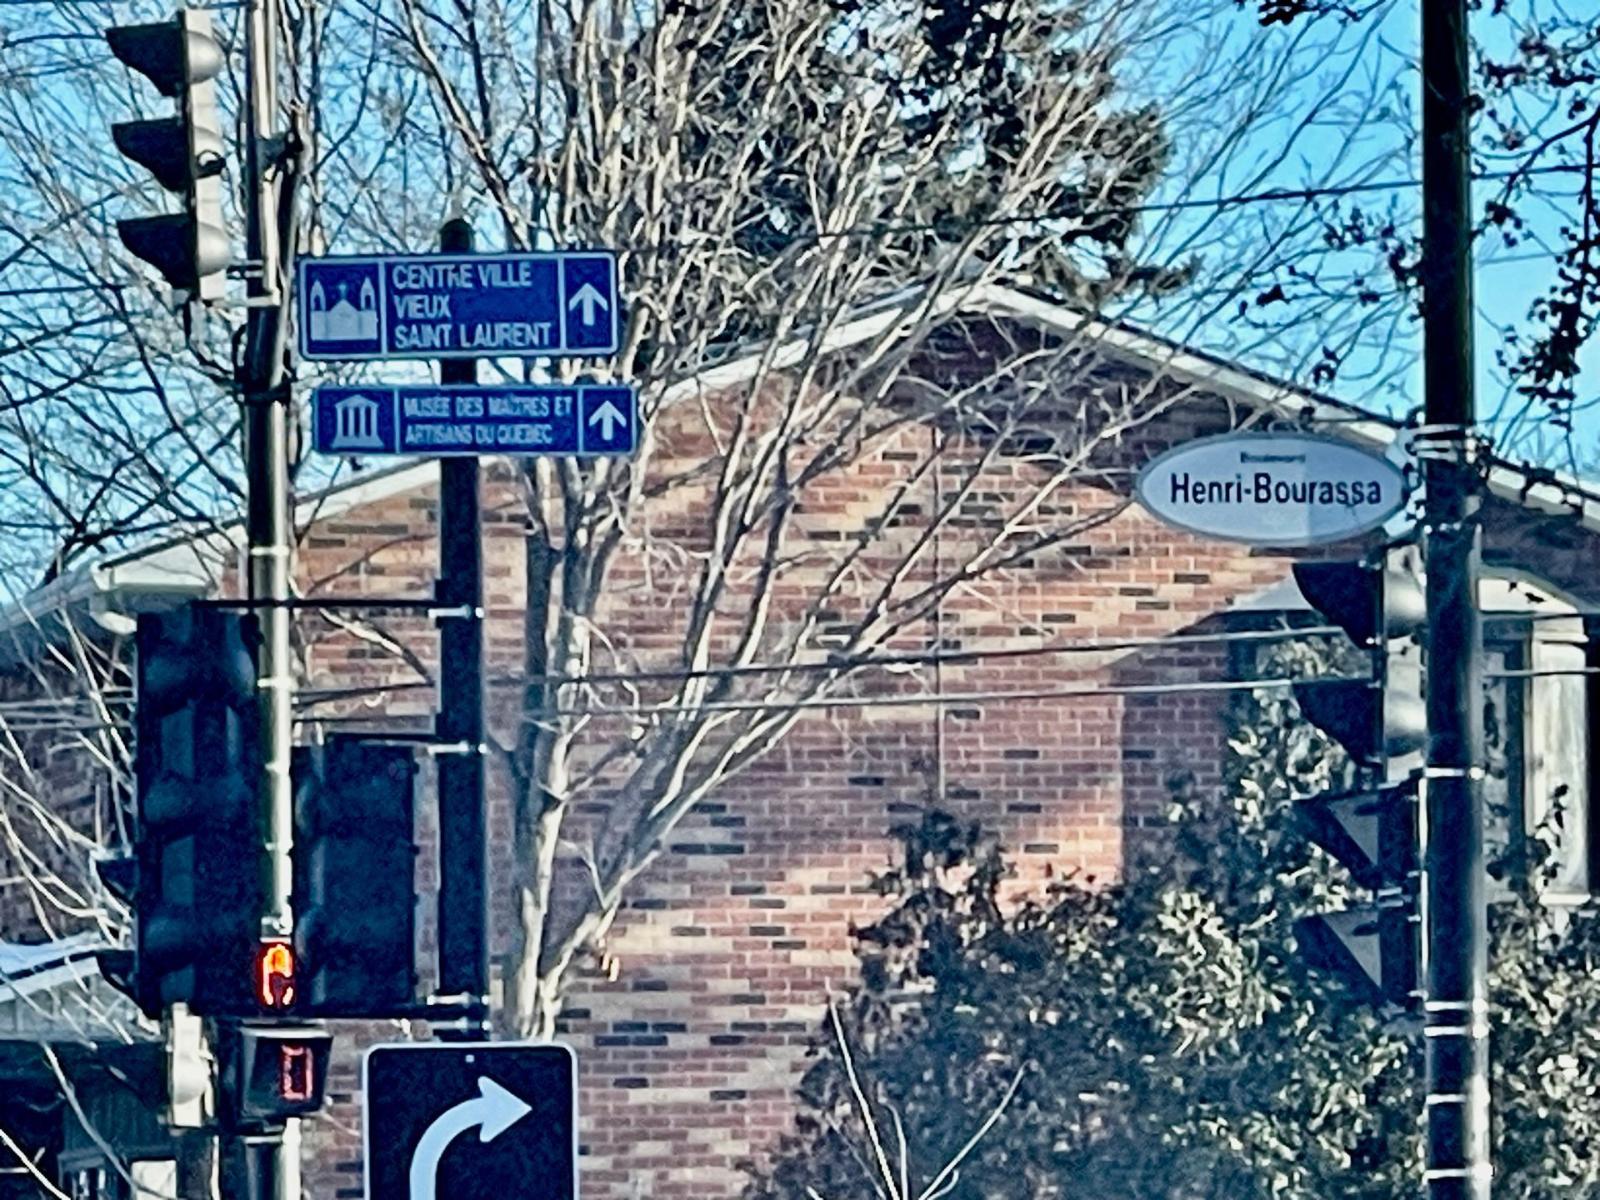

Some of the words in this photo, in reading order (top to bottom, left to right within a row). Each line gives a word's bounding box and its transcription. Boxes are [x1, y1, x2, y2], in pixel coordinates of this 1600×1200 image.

[392, 264, 473, 289] CENTRE
[478, 261, 532, 287] VILLE
[394, 294, 452, 319] VIEUX
[395, 324, 451, 349] SAINT
[460, 322, 552, 347] LAURENT
[455, 396, 484, 417] DES
[554, 396, 573, 416] ET
[405, 424, 473, 444] ARTISANS
[475, 424, 495, 444] DU
[1170, 473, 1382, 504] Henri-Bourassa
